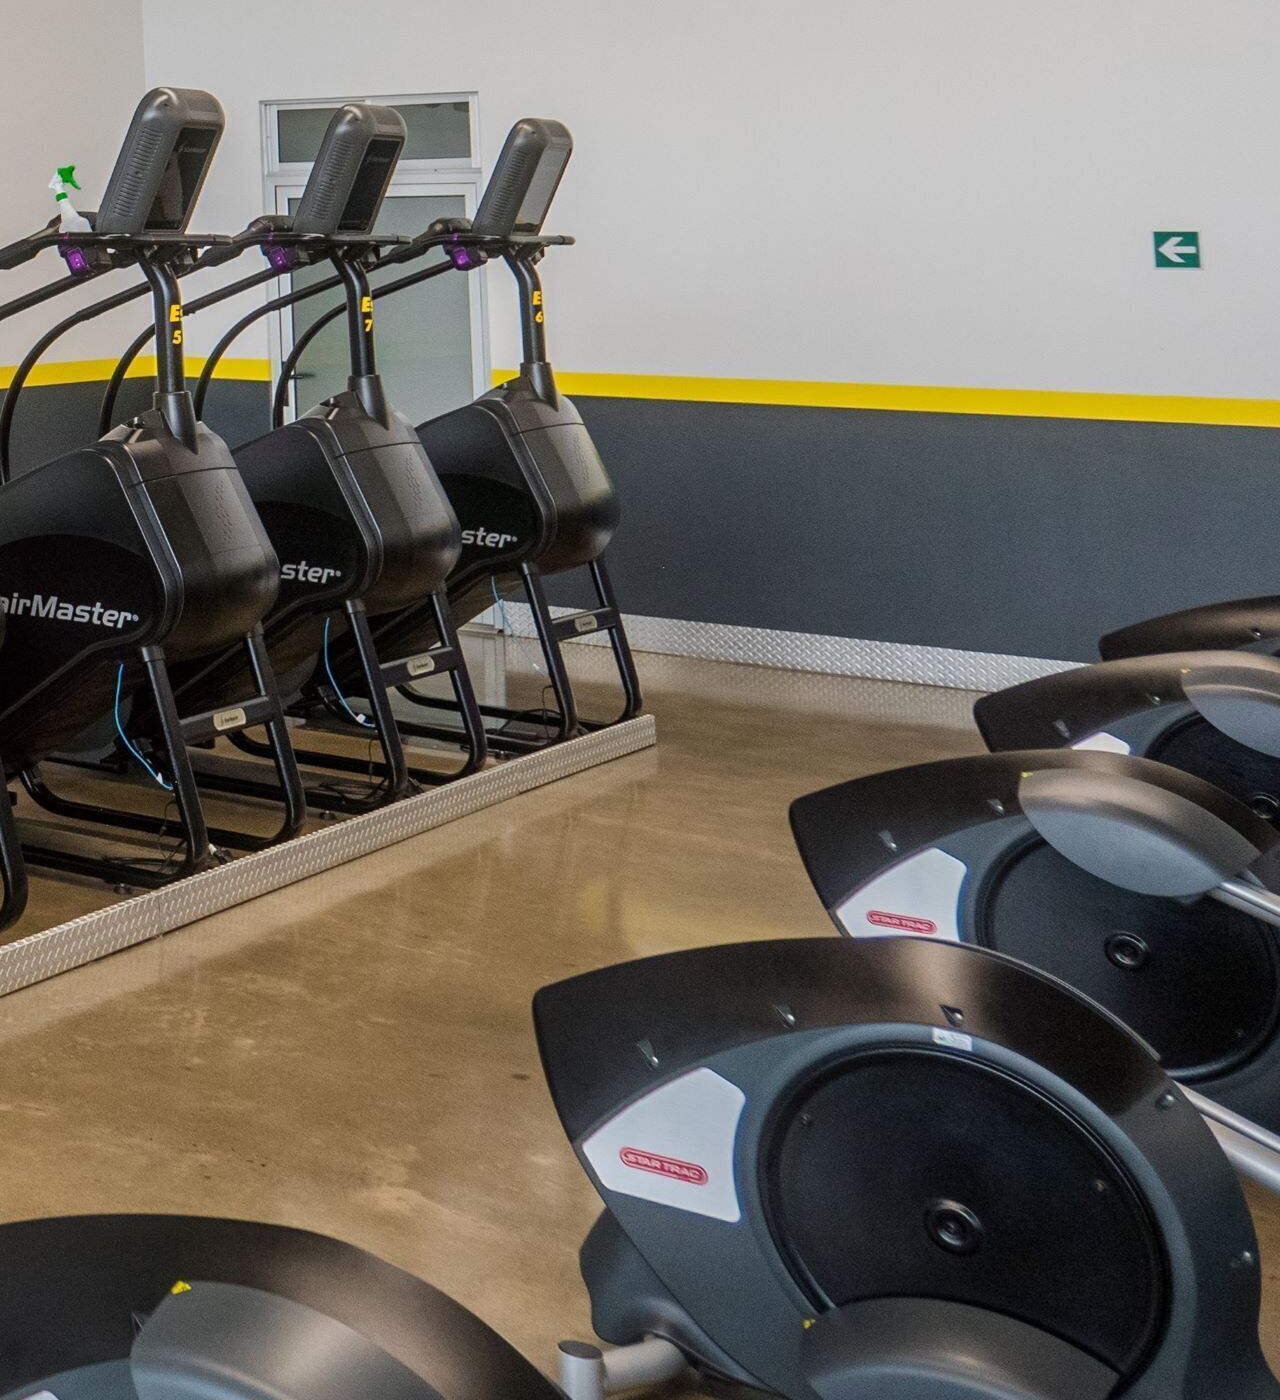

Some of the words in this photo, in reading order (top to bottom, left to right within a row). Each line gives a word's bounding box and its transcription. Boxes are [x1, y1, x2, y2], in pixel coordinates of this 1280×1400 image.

[170, 304, 183, 322] E
[362, 296, 373, 313] E
[172, 330, 182, 345] 5
[0, 592, 132, 629] airMaster
[624, 1151, 662, 1170] STAR
[661, 1161, 704, 1180] TRAC
